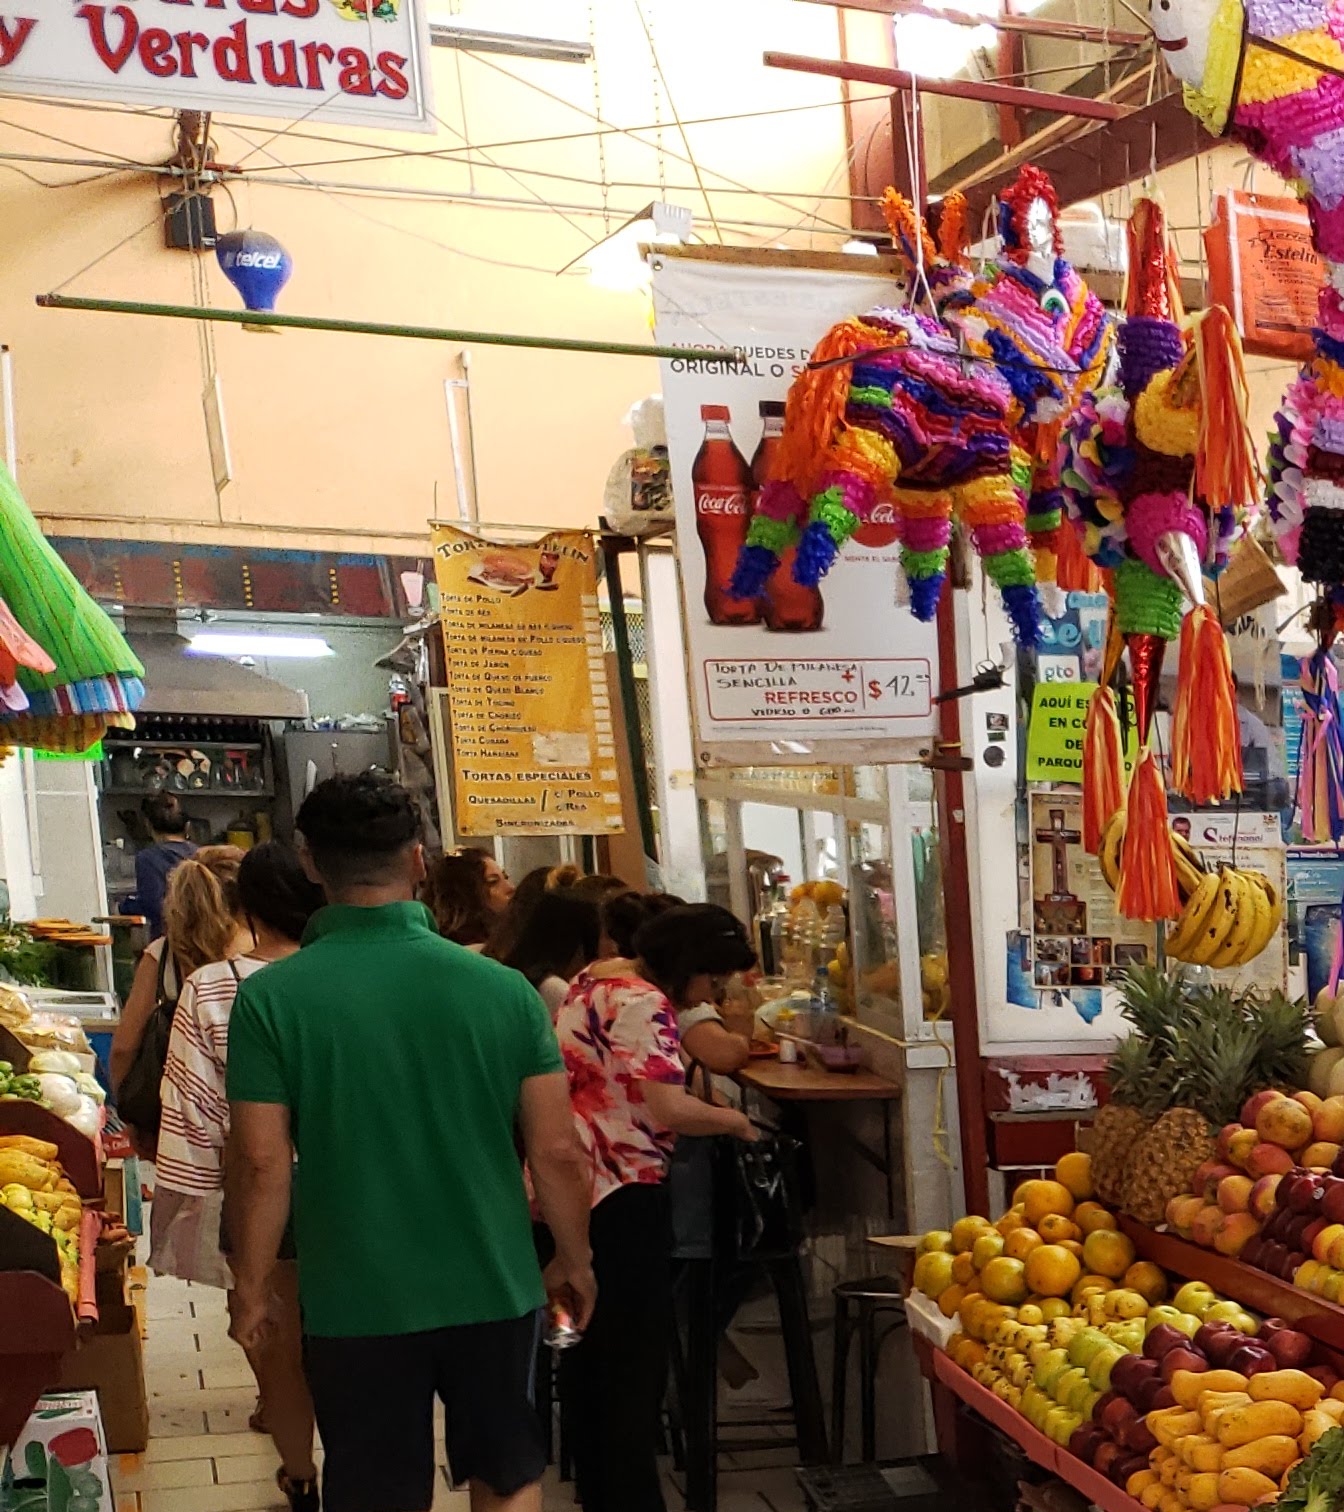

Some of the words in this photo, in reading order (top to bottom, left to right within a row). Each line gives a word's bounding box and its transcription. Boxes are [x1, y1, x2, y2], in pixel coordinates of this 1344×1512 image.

[75, 4, 409, 100] Verduras
[236, 251, 281, 270] telcel
[670, 359, 765, 377] ORIGINAL
[771, 364, 784, 377] O
[476, 595, 502, 604] POLLO
[714, 662, 757, 675] TORTA
[765, 662, 783, 672] DE
[1045, 664, 1073, 682] gto
[716, 676, 797, 689] SENCILLA
[764, 690, 858, 705] REFRESCO
[1039, 696, 1072, 709] AQUÍ
[1048, 718, 1067, 729] EN
[462, 769, 512, 781] TORTAS
[516, 770, 591, 781] ESPECIALES
[468, 795, 536, 804] QUESADILLAS
[568, 790, 601, 798] POLLO
